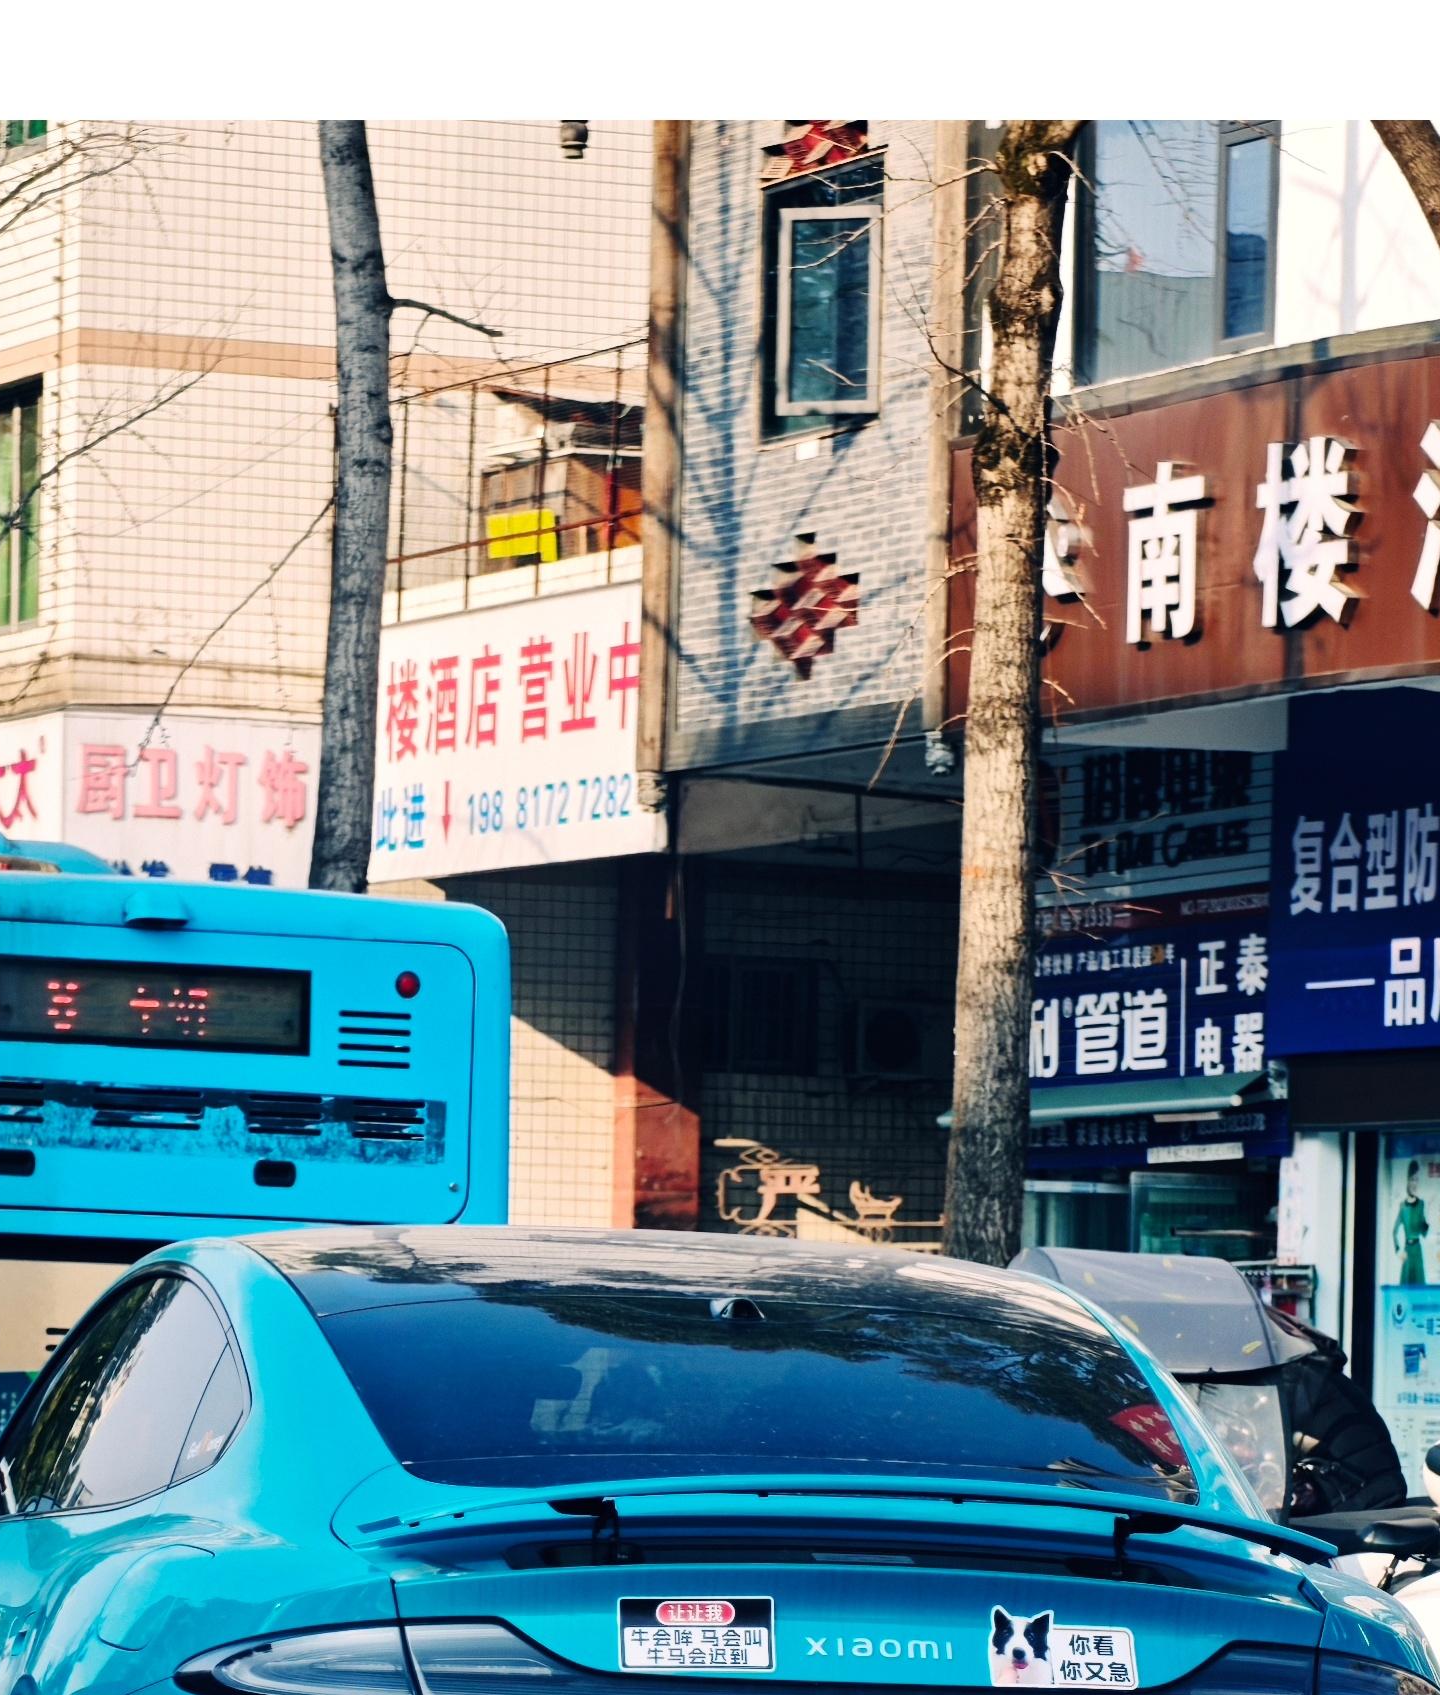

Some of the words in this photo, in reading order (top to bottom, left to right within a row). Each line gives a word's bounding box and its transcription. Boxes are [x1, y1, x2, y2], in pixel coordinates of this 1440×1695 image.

[76, 743, 310, 829] 厨卫灯饰
[1194, 932, 1270, 997] 正泰
[1194, 1012, 1265, 1077] 电器
[1059, 1659, 1133, 1685] 你又急
[1068, 1633, 1115, 1658] 你看
